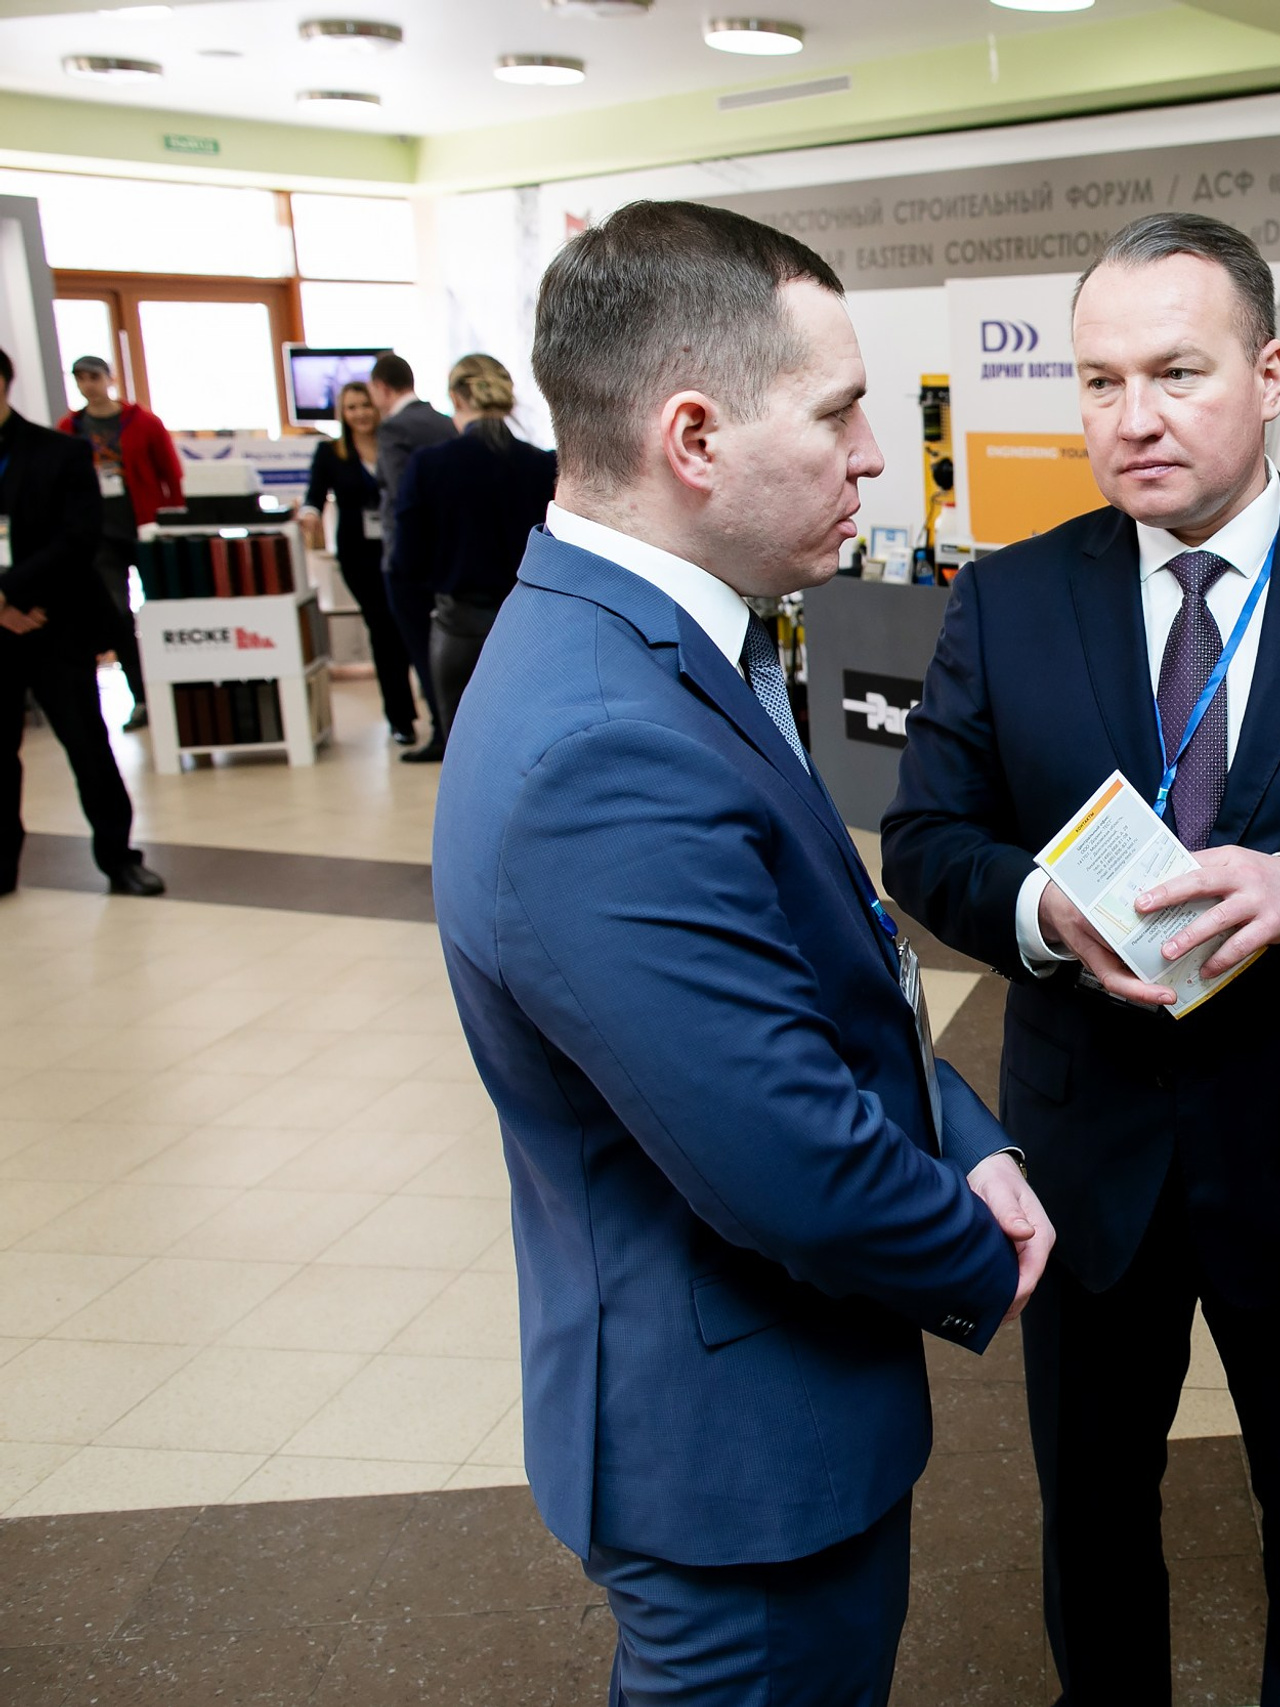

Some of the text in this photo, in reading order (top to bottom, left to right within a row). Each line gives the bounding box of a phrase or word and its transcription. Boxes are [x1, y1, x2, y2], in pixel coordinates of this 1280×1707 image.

[893, 182, 1054, 226] СТРОИТЕЛЬНЫЙ
[1065, 177, 1154, 209] ФОРУМ
[1193, 169, 1255, 203] ДСФ
[856, 243, 933, 271] EASTERN
[944, 230, 1107, 265] CONSTRUCTION
[981, 361, 1074, 380] ДОРИНГ ВОСТОК
[162, 627, 230, 645] RECKE
[843, 691, 920, 736] Par
[1074, 810, 1095, 833] КОНТАКТЫ
